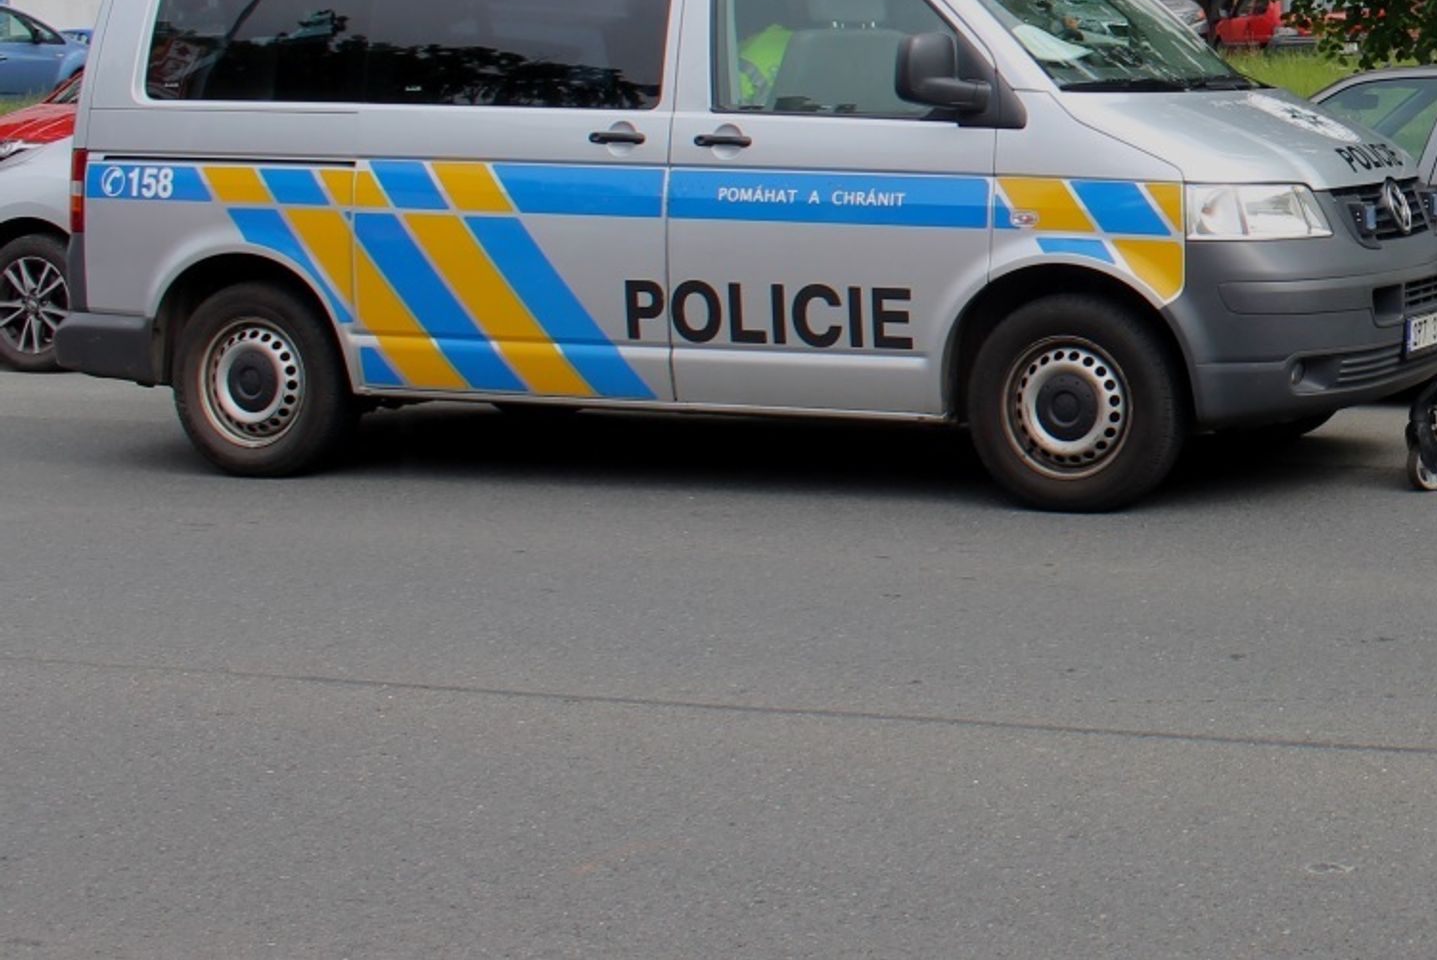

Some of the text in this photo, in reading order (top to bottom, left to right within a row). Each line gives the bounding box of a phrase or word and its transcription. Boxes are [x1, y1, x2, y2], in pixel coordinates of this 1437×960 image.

[1334, 143, 1404, 174] POLICIE
[128, 166, 174, 198] 158
[717, 185, 906, 206] POMÁHAT A CHRÁNIT
[624, 279, 913, 350] POLICIE
